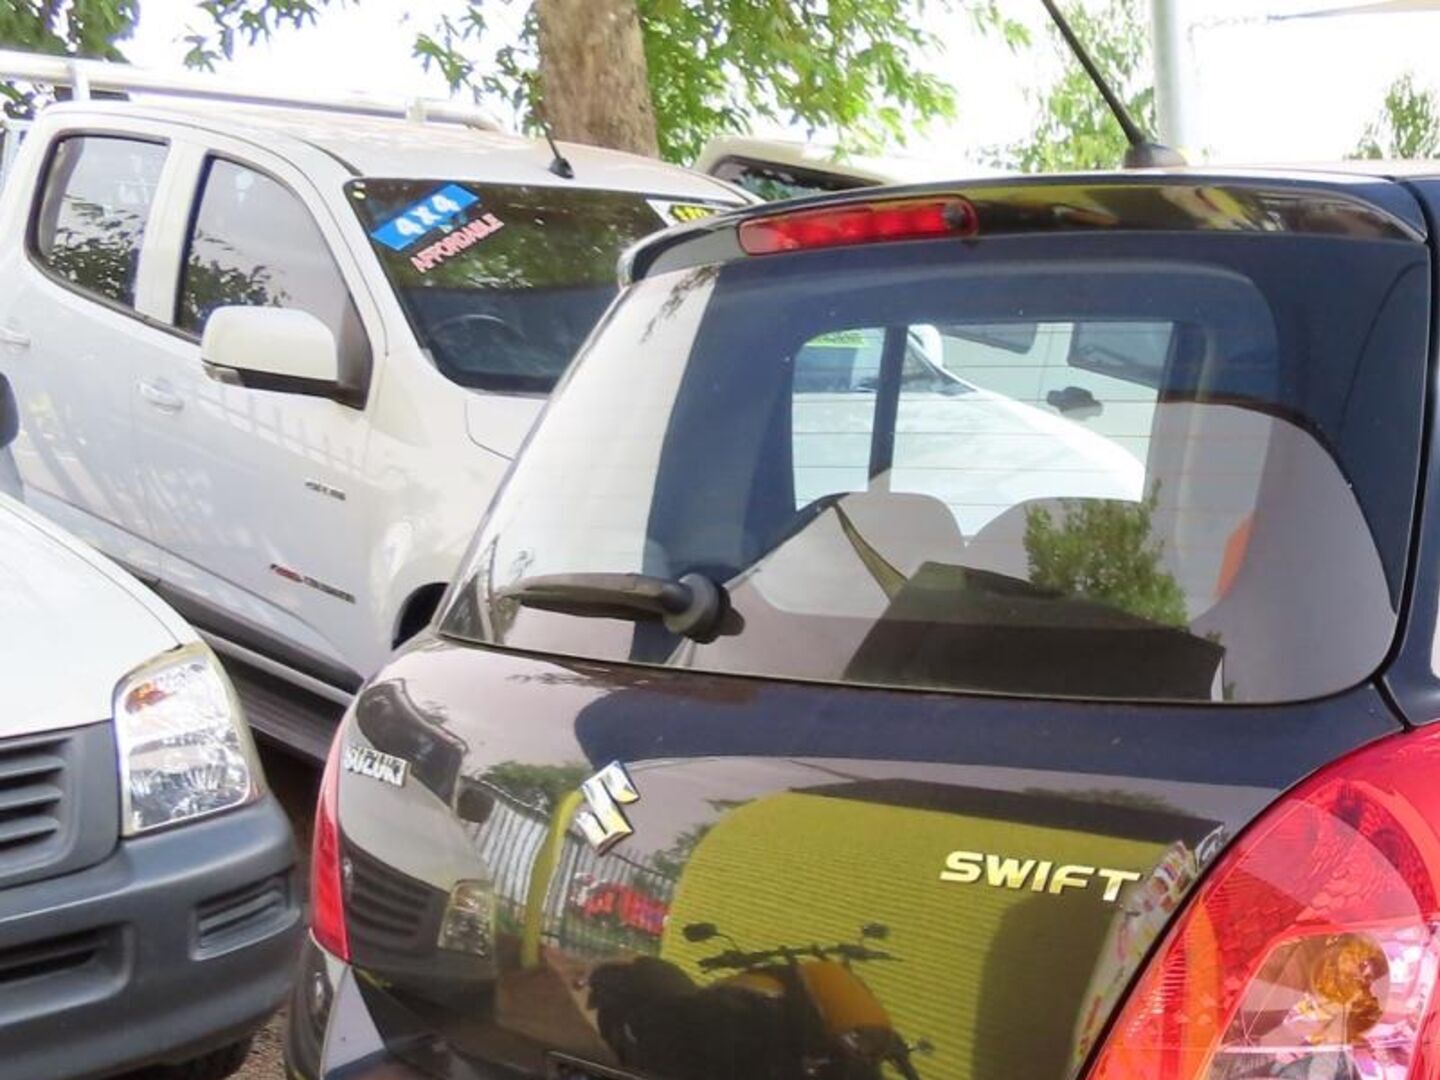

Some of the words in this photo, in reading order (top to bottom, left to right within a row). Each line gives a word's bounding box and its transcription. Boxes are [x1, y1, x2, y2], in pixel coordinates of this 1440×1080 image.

[410, 213, 505, 273] AFFORDABLE
[343, 746, 408, 787] SUZUKI
[940, 850, 1141, 903] SWIFT
